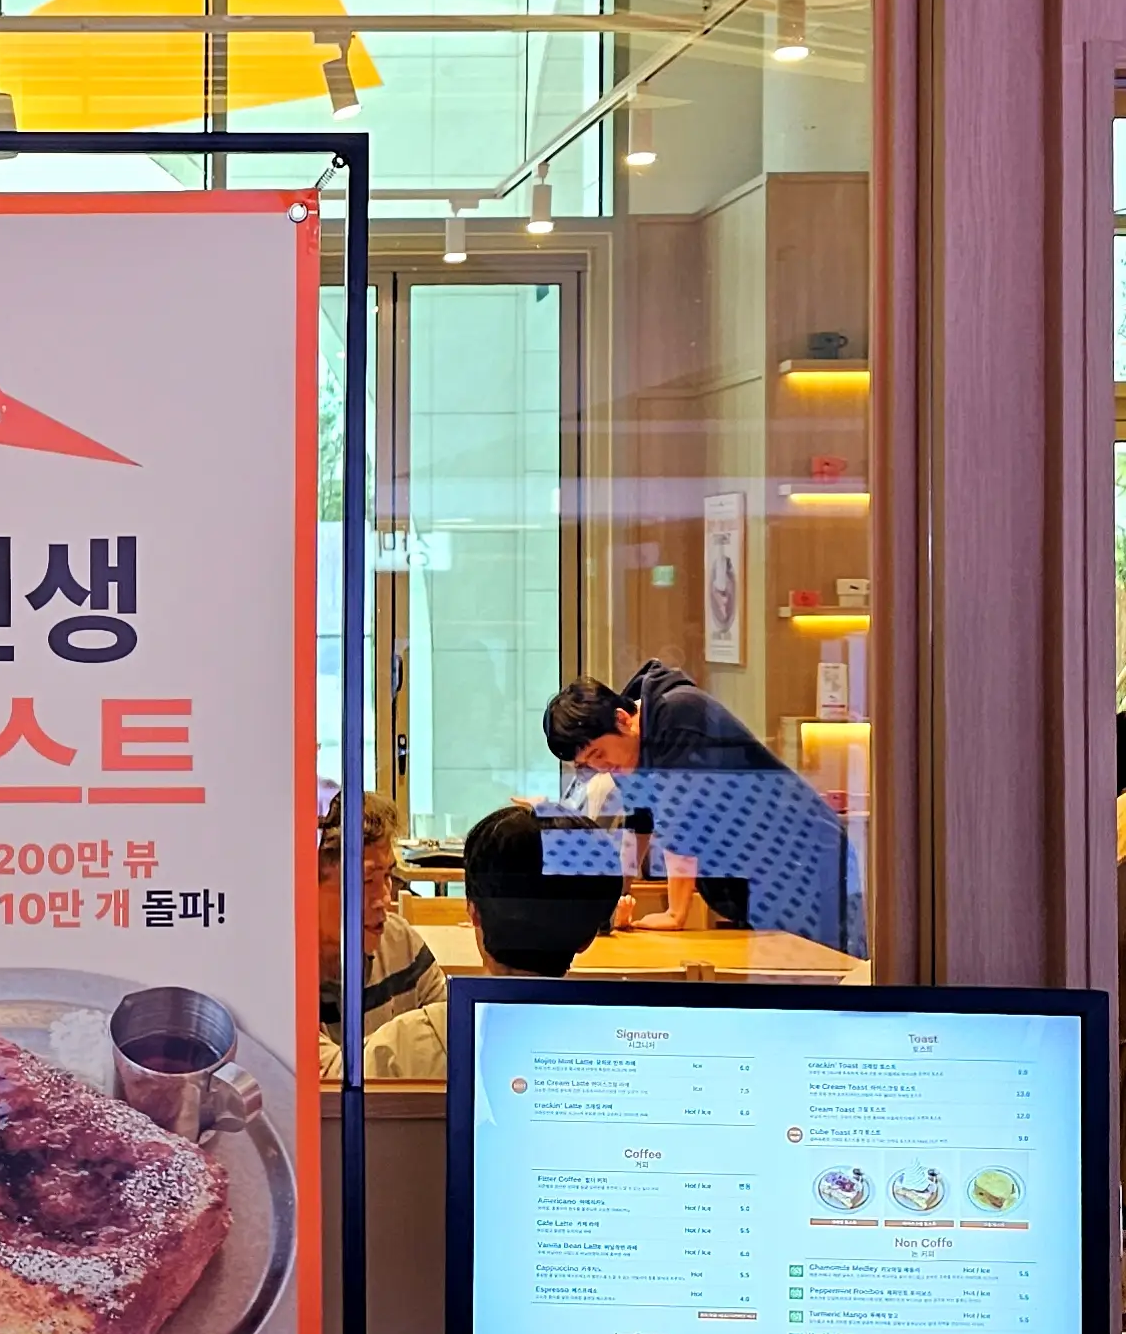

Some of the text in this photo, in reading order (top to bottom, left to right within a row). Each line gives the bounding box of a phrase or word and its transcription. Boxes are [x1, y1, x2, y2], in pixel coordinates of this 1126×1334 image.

[122, 839, 160, 879] 뷰
[94, 889, 131, 929] 개
[141, 888, 226, 928] 돌파!
[616, 1029, 669, 1040] Signature
[908, 1034, 938, 1044] Toast
[624, 1149, 662, 1159] Coffee
[894, 1238, 918, 1248] Non
